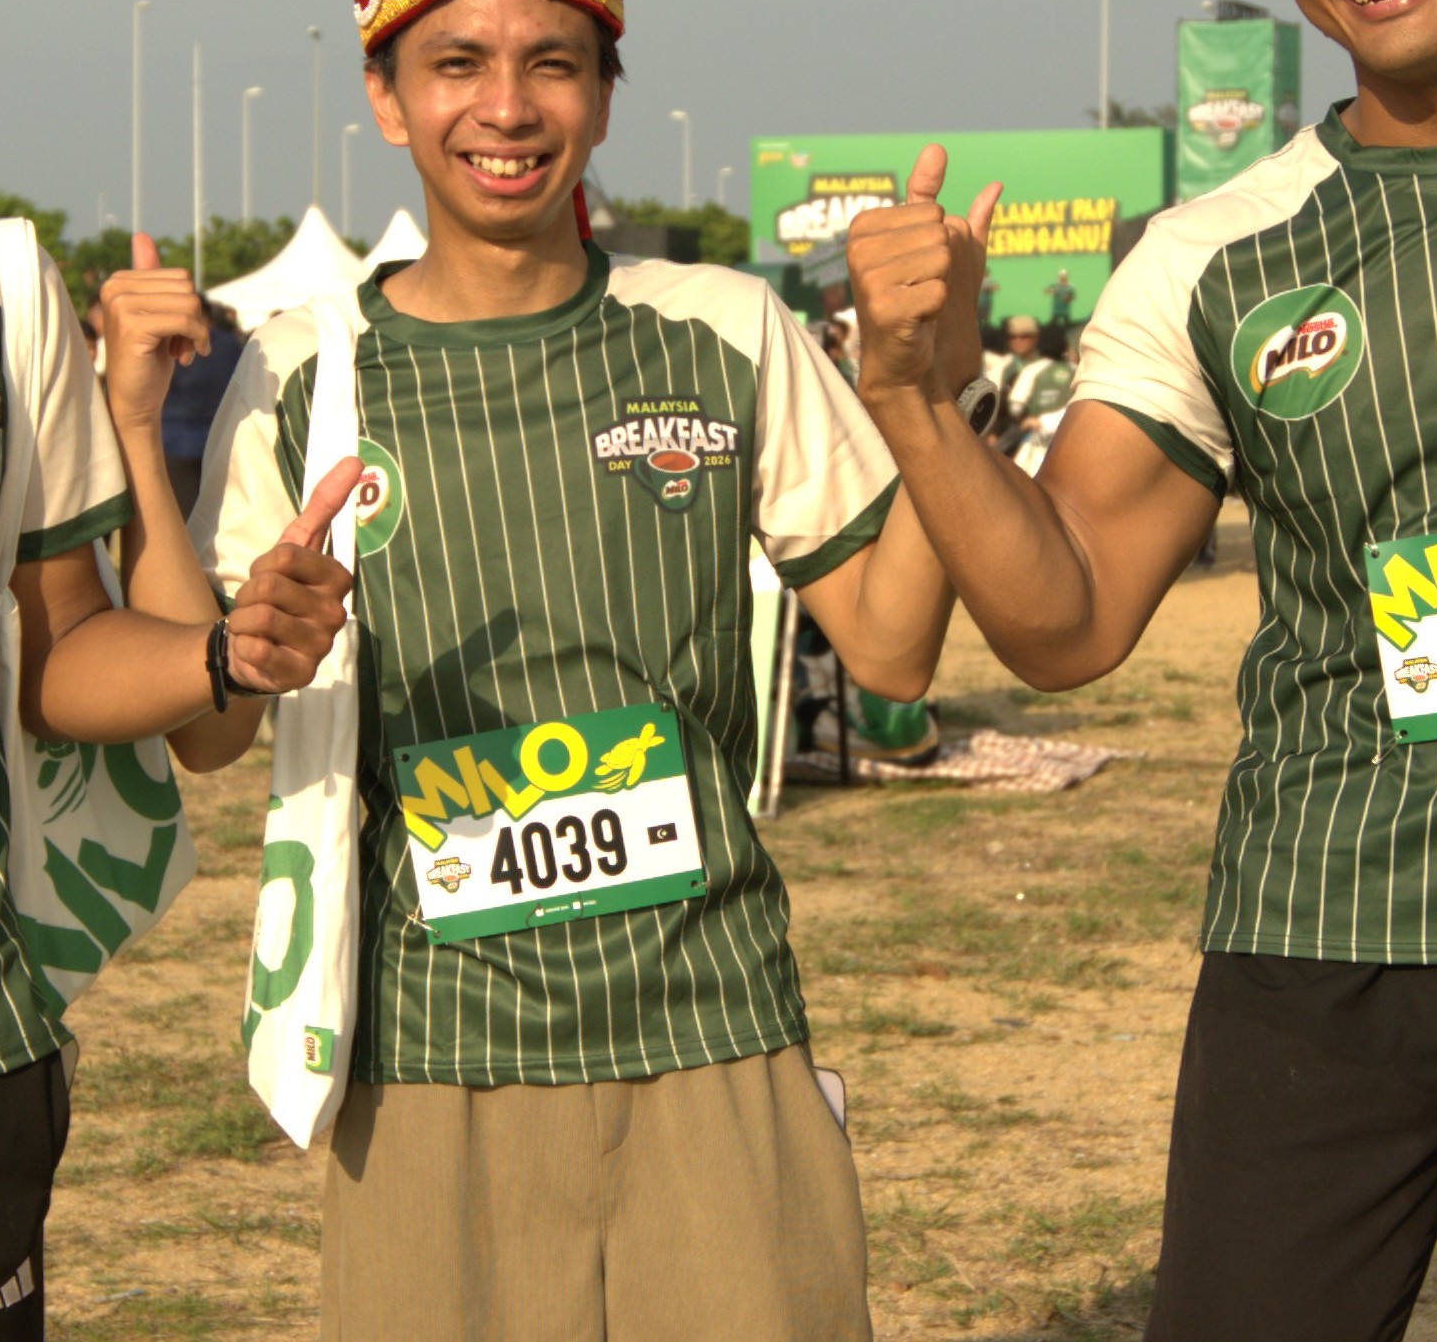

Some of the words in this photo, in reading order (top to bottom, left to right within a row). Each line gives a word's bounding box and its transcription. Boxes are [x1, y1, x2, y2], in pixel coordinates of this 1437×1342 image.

[1265, 329, 1336, 379] MILO
[626, 400, 700, 414] MALAYSIA
[595, 416, 738, 458] BREAKFAST
[608, 460, 632, 471] DAY
[704, 455, 731, 466] 2026
[402, 721, 588, 850] MILO
[490, 808, 628, 895] 4039
